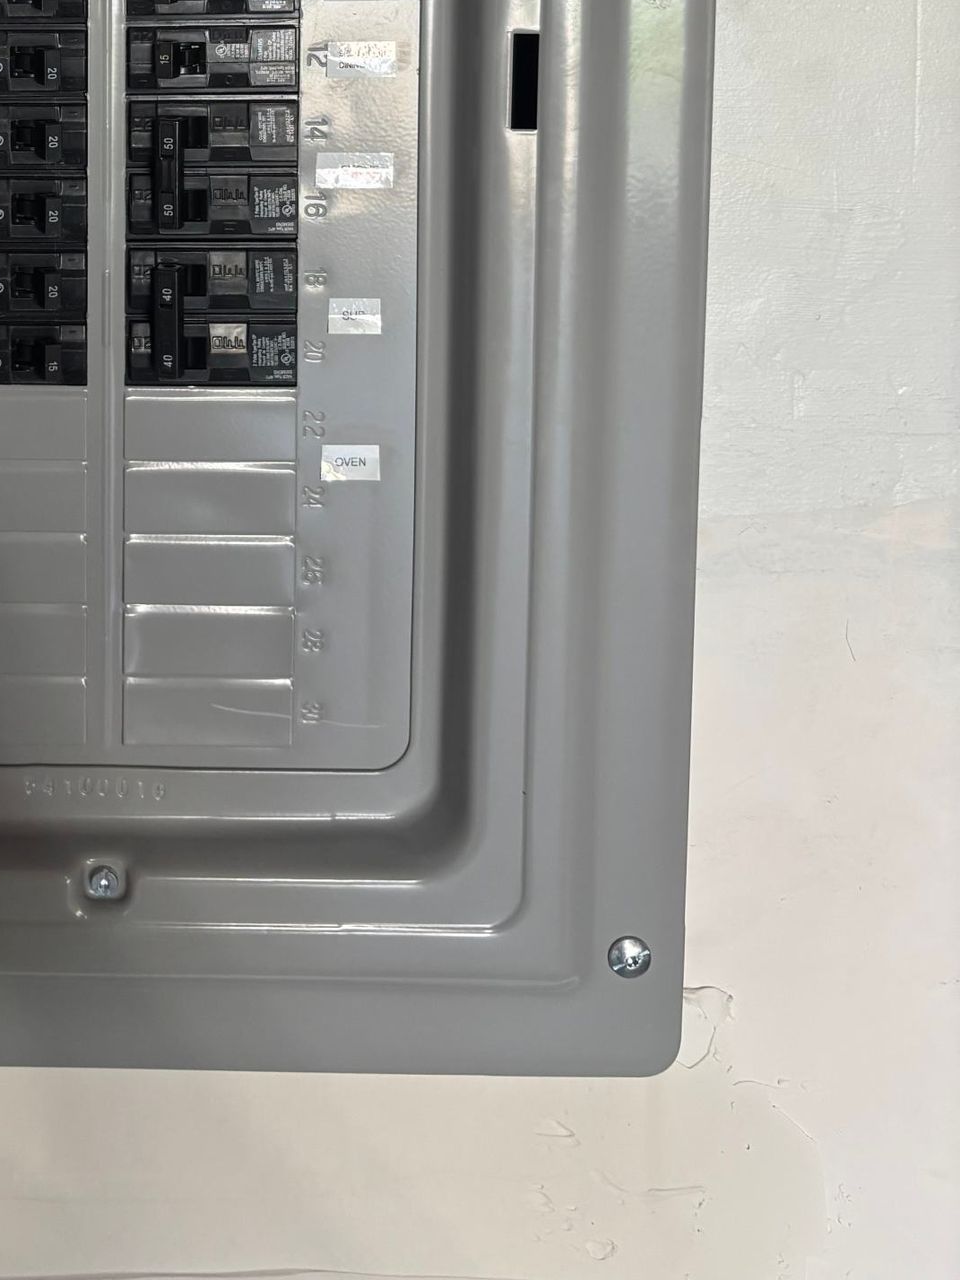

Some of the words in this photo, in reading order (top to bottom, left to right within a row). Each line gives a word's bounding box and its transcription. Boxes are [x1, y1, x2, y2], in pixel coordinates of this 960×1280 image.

[160, 55, 169, 64] 15
[48, 68, 57, 79] 20
[303, 117, 329, 141] 14
[49, 136, 58, 147] 20
[164, 138, 173, 149] 50
[303, 191, 328, 218] 16
[164, 205, 173, 216] 50
[49, 211, 58, 222] 20
[49, 286, 58, 297] 20
[162, 289, 172, 301] 40
[49, 362, 57, 371] 15
[163, 355, 172, 367] 40
[335, 457, 366, 467] OVEN
